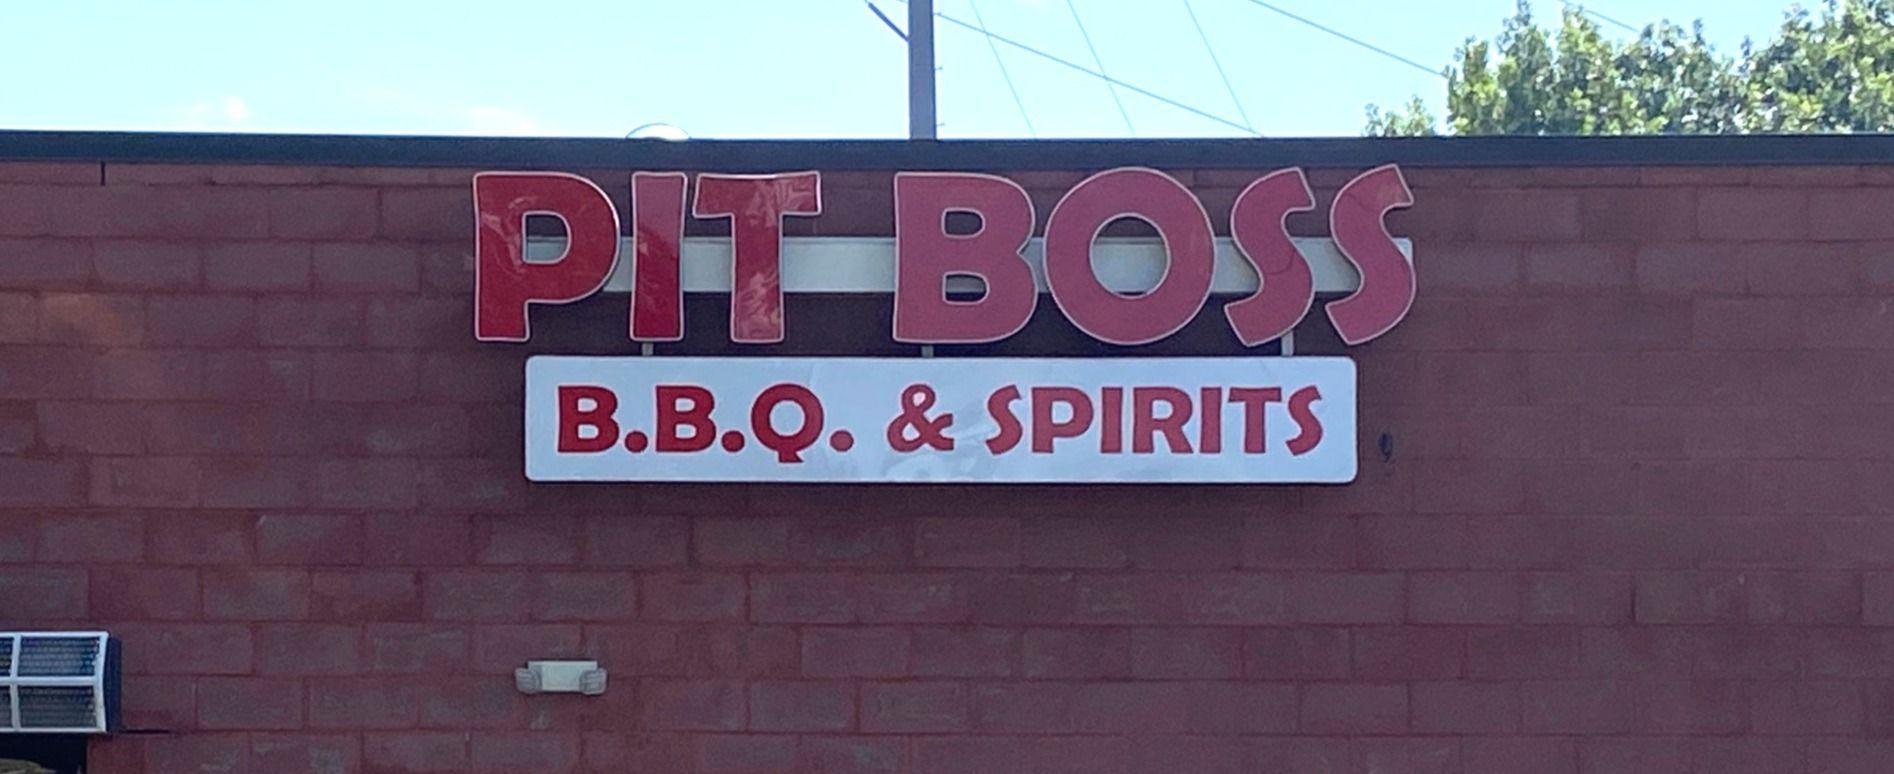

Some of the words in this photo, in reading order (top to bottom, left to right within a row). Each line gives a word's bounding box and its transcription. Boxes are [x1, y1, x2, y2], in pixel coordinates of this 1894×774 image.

[473, 170, 821, 342] PIT
[892, 164, 1416, 345] BOSS
[557, 383, 855, 463] B.B.Q.
[887, 384, 954, 453] &
[985, 384, 1324, 455] SPIRITS
